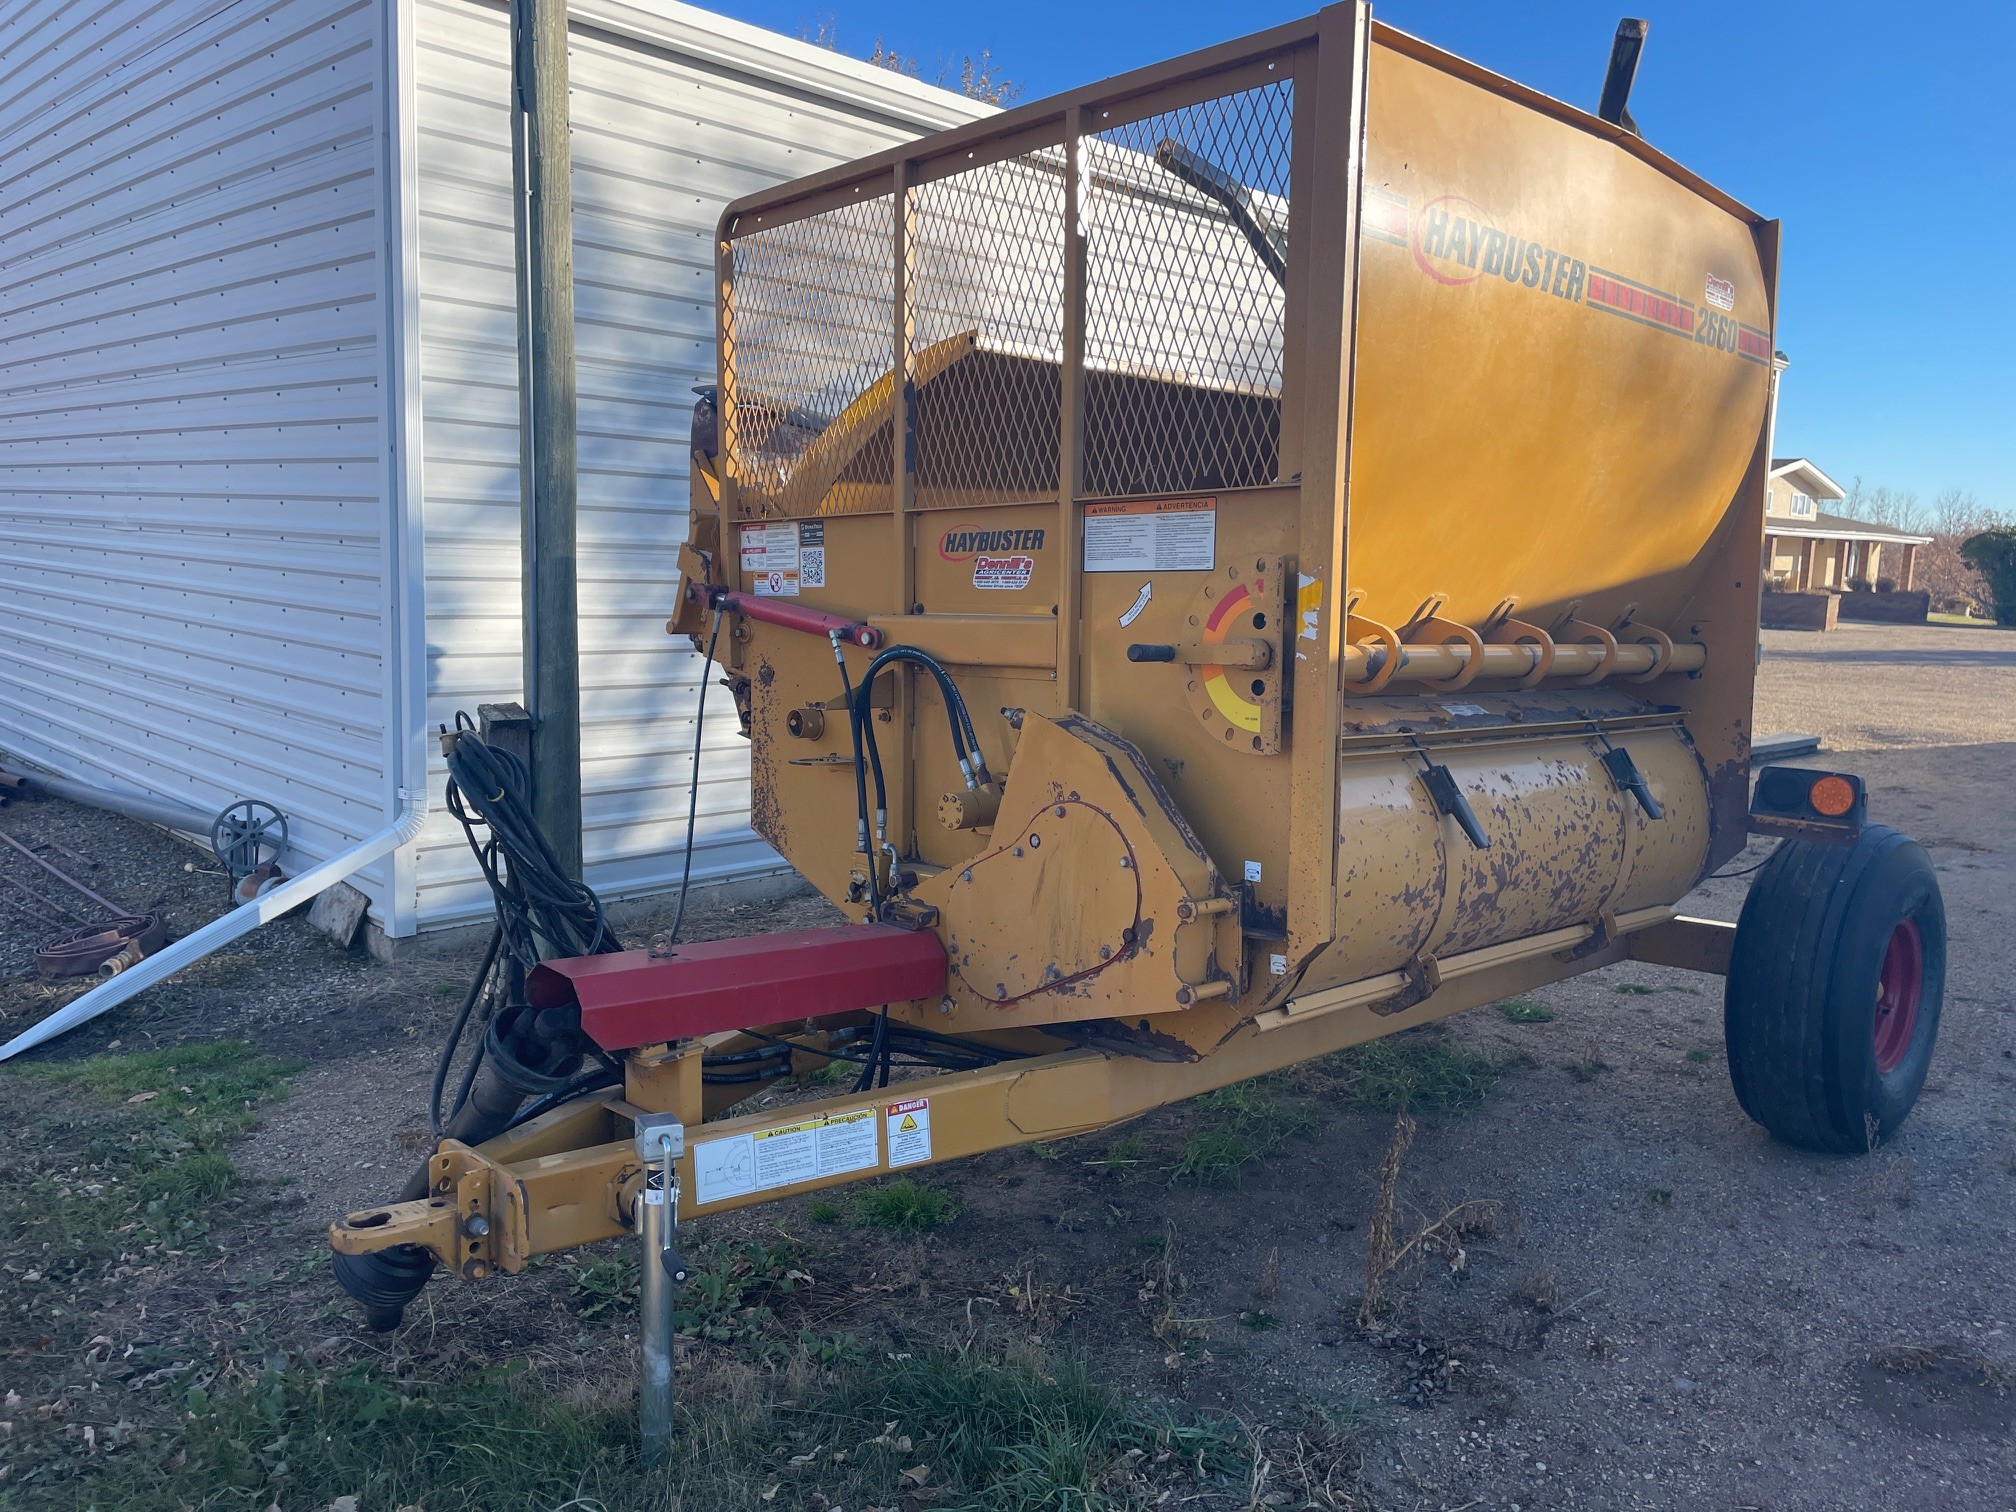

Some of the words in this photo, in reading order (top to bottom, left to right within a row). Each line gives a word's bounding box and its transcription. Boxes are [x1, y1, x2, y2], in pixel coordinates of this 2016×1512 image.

[1423, 207, 1586, 303] HAYBUSTER
[1694, 306, 1738, 353] 2660
[1097, 505, 1127, 513] WARNING
[1162, 501, 1209, 510] ADVERTENCIA
[944, 529, 1045, 553] HAYBUSTER
[898, 1100, 924, 1111] DANGER
[830, 1113, 867, 1125] PRECAUCIÓN
[774, 1126, 801, 1136] CAUTION
